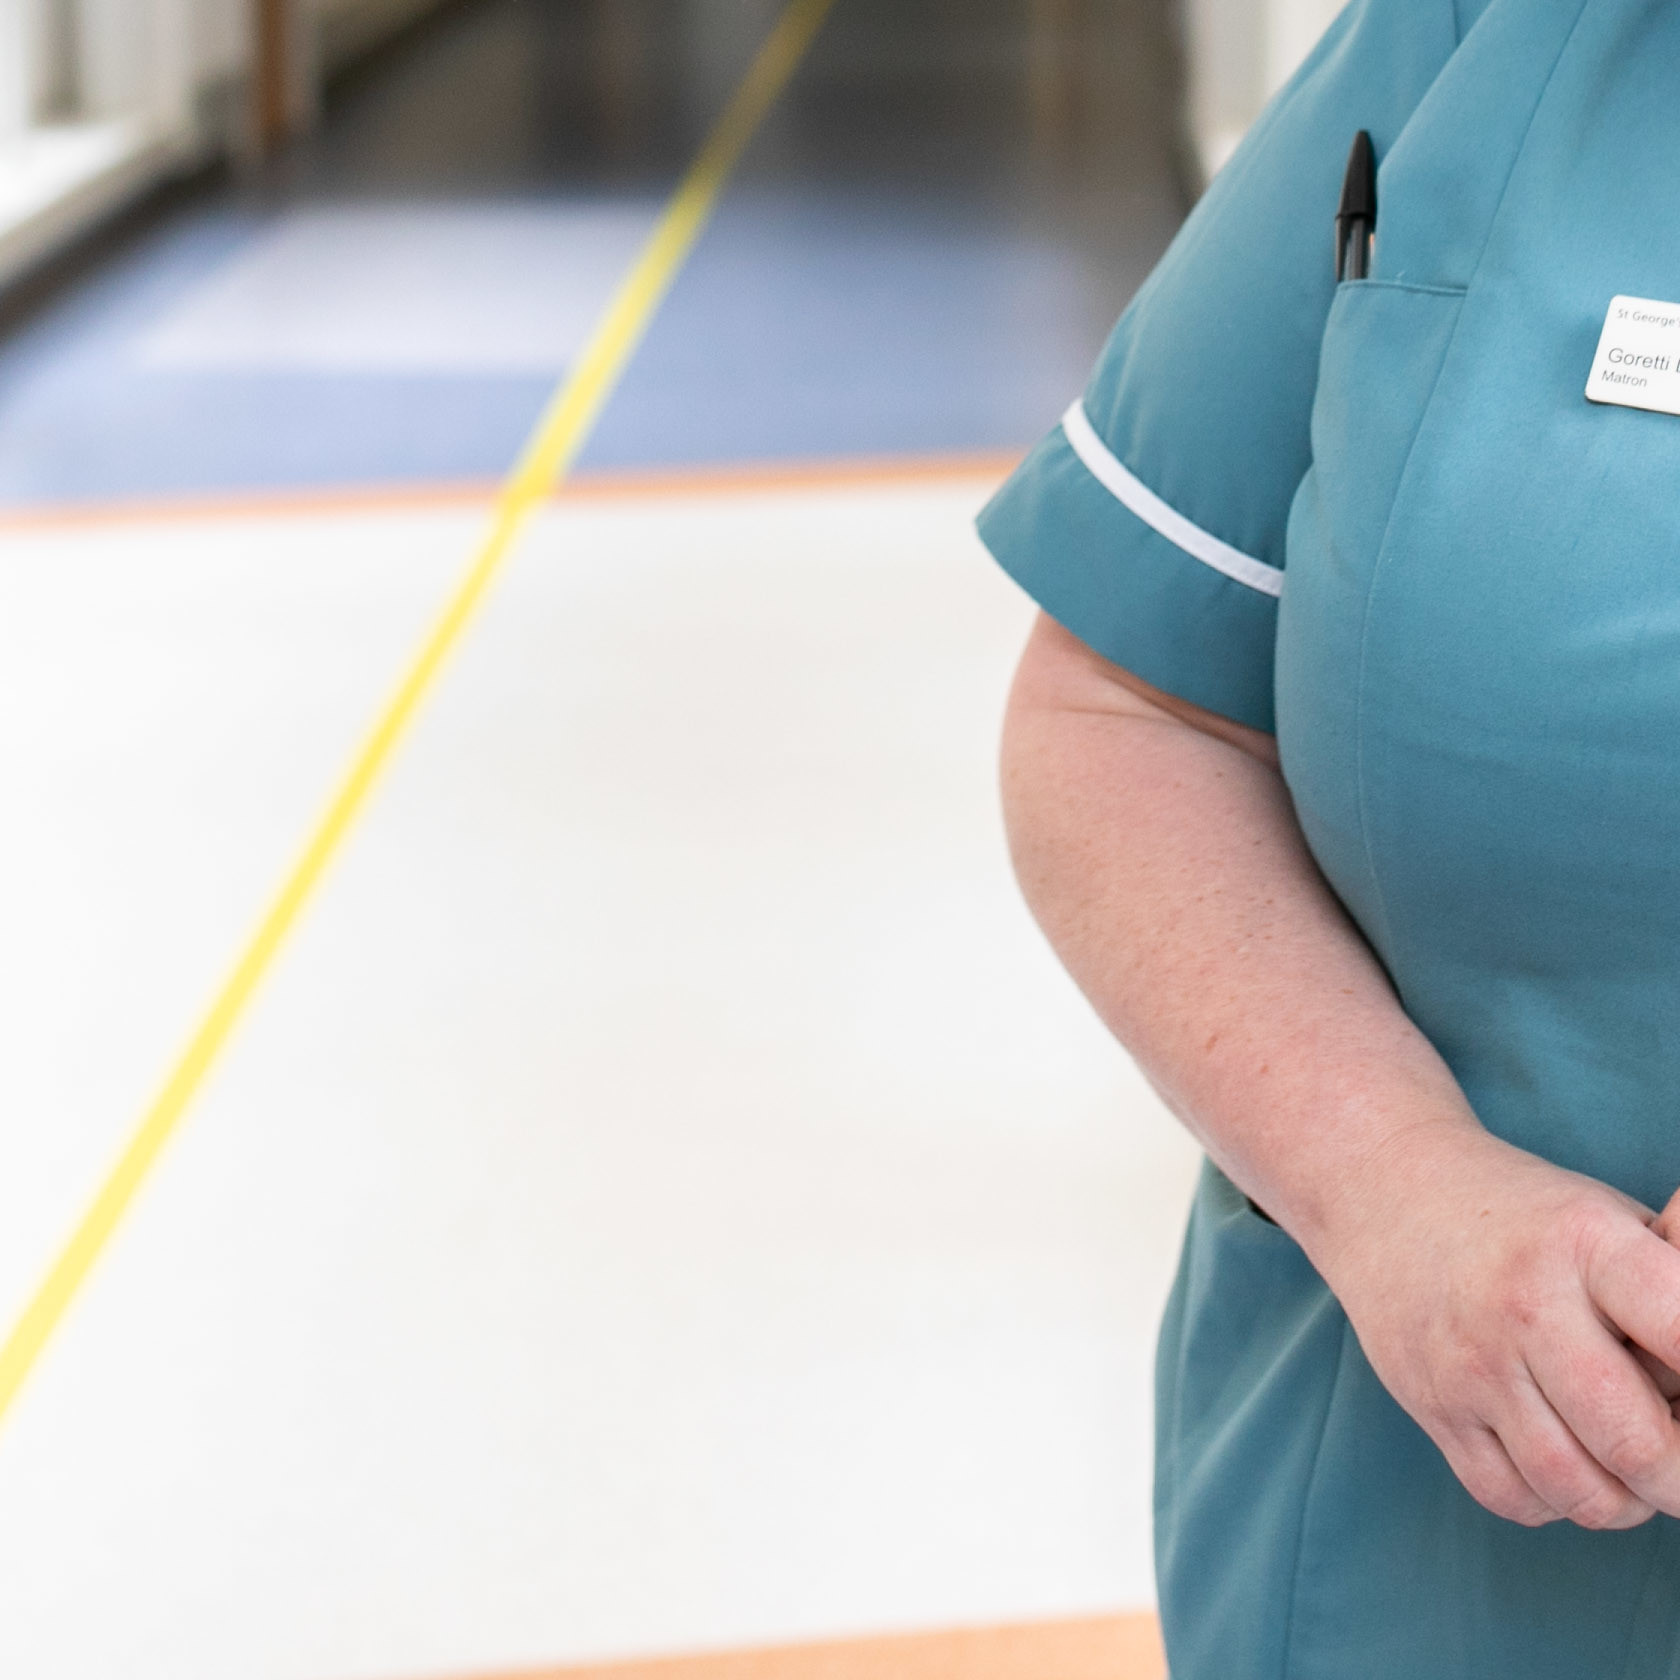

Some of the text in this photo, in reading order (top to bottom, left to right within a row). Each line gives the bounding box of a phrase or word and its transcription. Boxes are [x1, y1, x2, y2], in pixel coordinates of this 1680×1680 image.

[1617, 308, 1629, 319] St
[1608, 347, 1671, 371] Goretti
[1601, 370, 1648, 387] Matron
